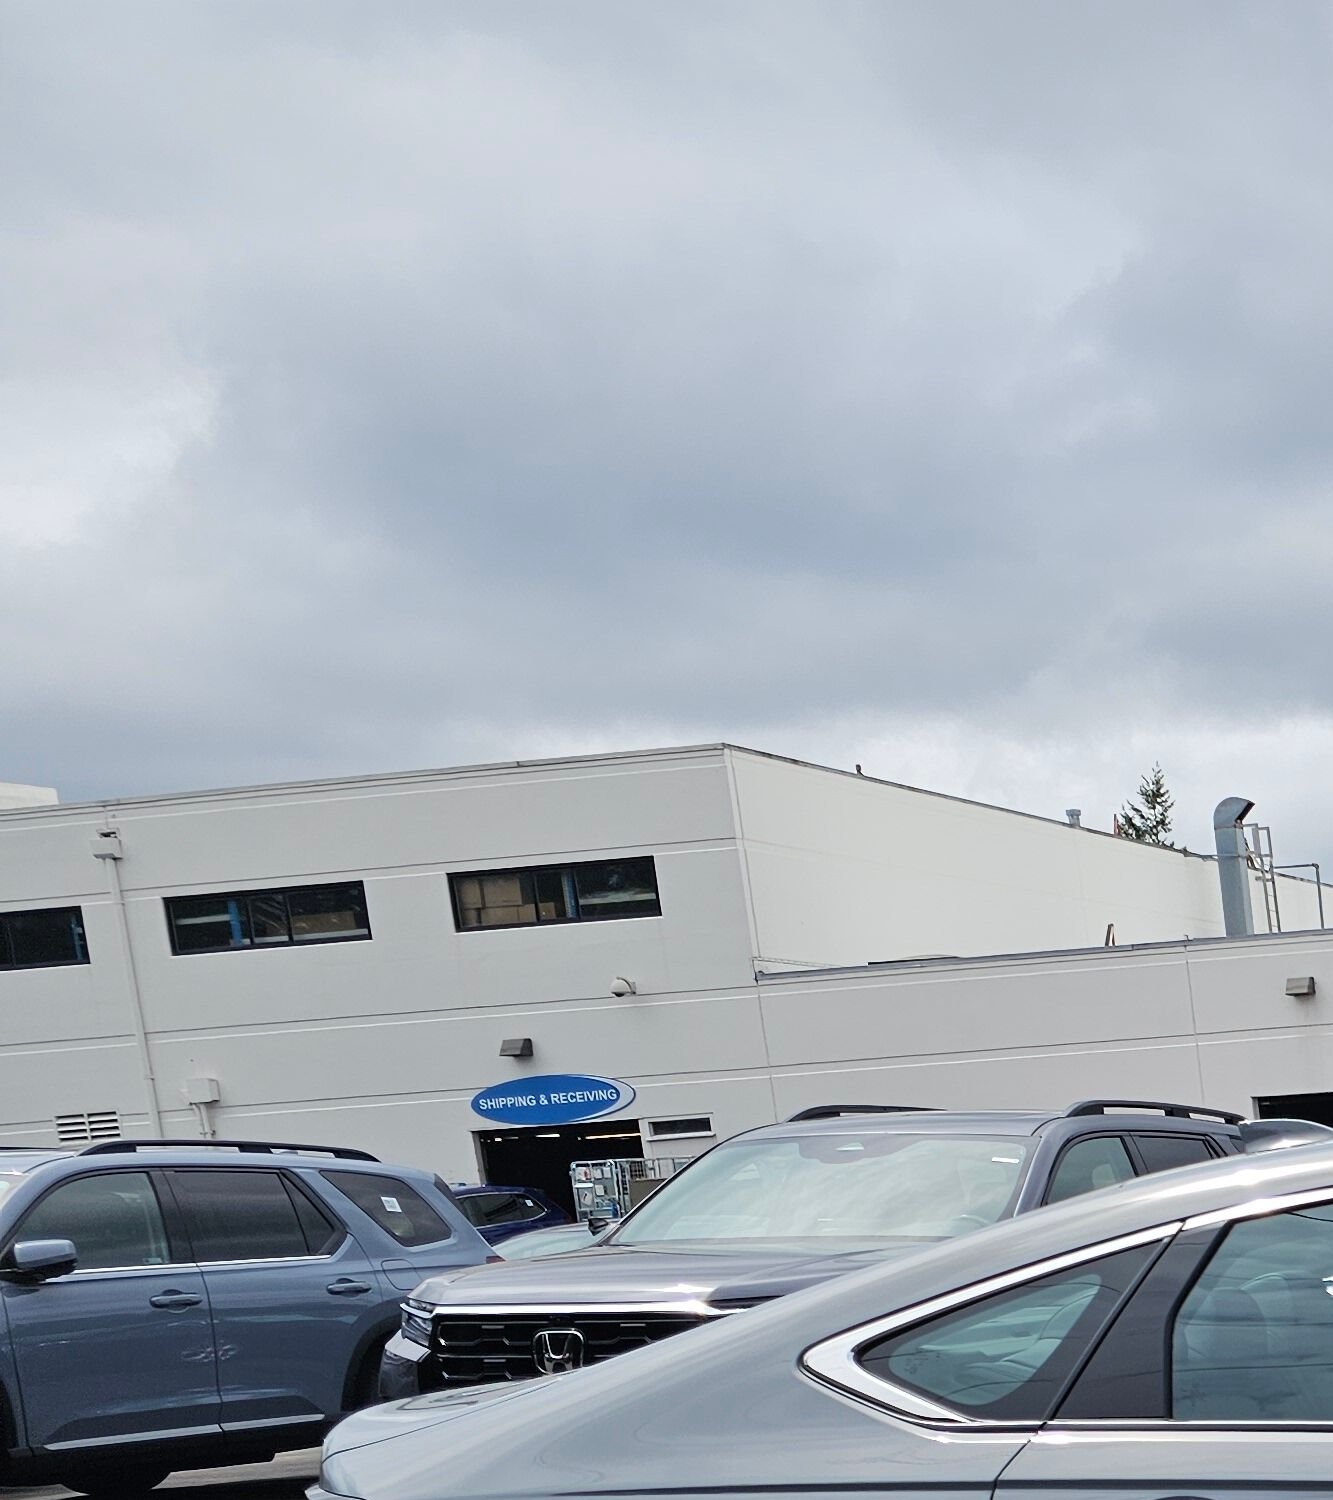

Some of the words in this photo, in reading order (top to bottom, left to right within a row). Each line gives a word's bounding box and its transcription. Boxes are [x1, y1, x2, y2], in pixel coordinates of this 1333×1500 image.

[479, 1095, 537, 1111] SHIPPING
[539, 1093, 549, 1106] &
[549, 1088, 618, 1105] RECEIVING
